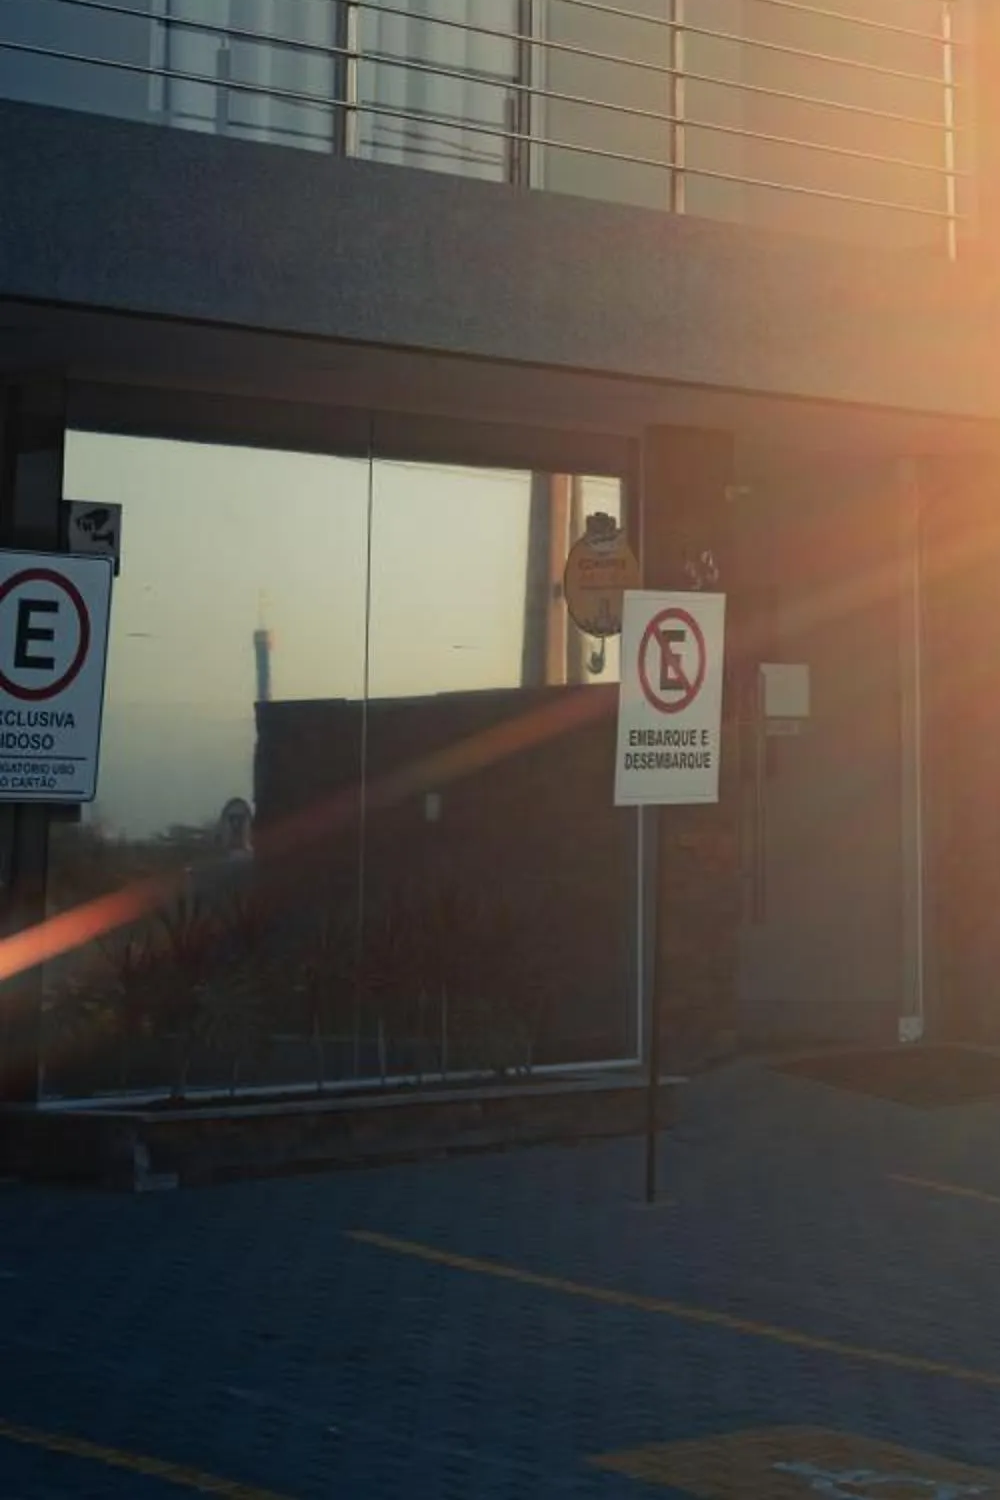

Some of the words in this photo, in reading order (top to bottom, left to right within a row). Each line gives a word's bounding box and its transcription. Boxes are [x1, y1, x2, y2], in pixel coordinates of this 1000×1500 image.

[14, 597, 59, 670] E
[0, 732, 54, 750] IDOSO
[629, 729, 696, 748] EMBARQUE
[701, 729, 710, 747] E
[624, 752, 711, 770] DESEMBARQUE
